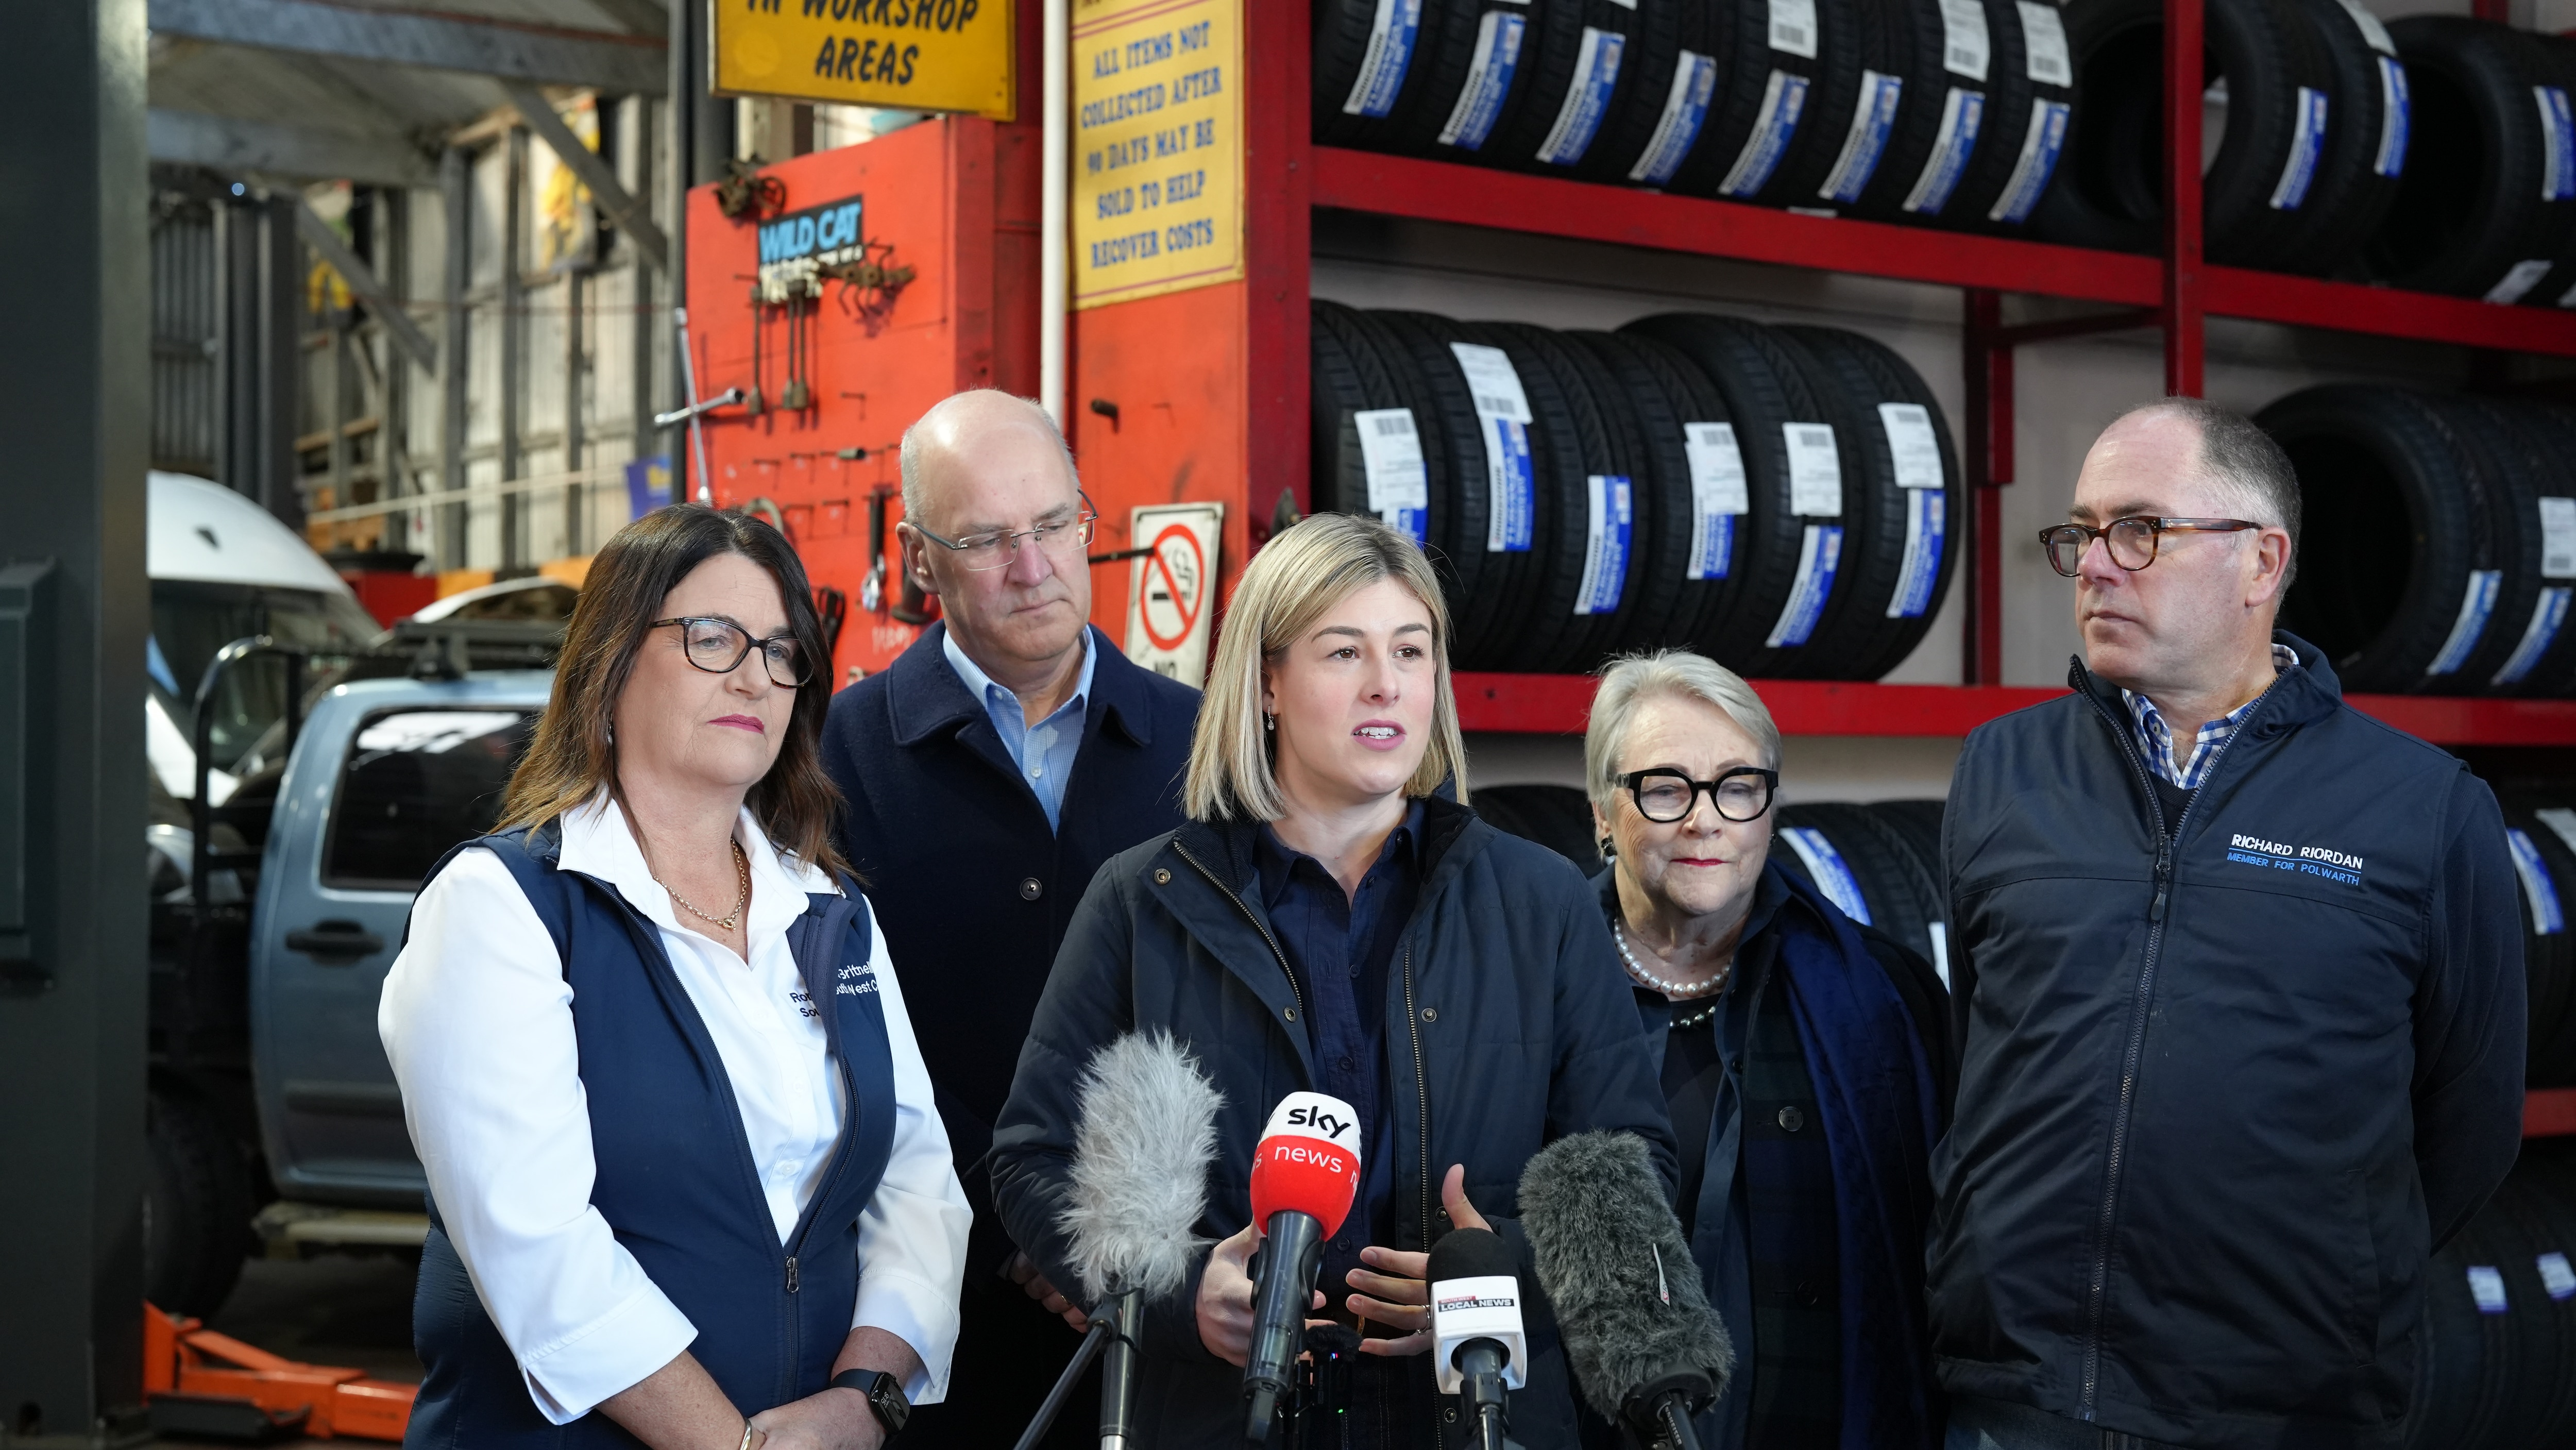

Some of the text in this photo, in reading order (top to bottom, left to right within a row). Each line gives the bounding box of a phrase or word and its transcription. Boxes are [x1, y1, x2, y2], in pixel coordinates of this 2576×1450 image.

[815, 36, 919, 86] AREAS
[1093, 20, 1210, 79] ALL ITEMS NOT
[1081, 66, 1222, 129] COLLECTED AFTER
[1108, 136, 1148, 170] DAYS
[1155, 125, 1189, 158] MAY
[1195, 119, 1215, 148] BE
[1097, 170, 1205, 220] SOLD TO HELP
[759, 216, 816, 264] WILD
[817, 202, 862, 250] CAT
[1092, 218, 1213, 268] RECOVER COSTS
[2227, 852, 2359, 886] MEMBER FOR POLWARTH
[2231, 834, 2363, 869] RICHARD RIORDAN
[1287, 1106, 1351, 1139] sky
[1275, 1146, 1342, 1173] news
[1442, 1301, 1478, 1311] LOCAL
[881, 1391, 889, 1406] 9:15
